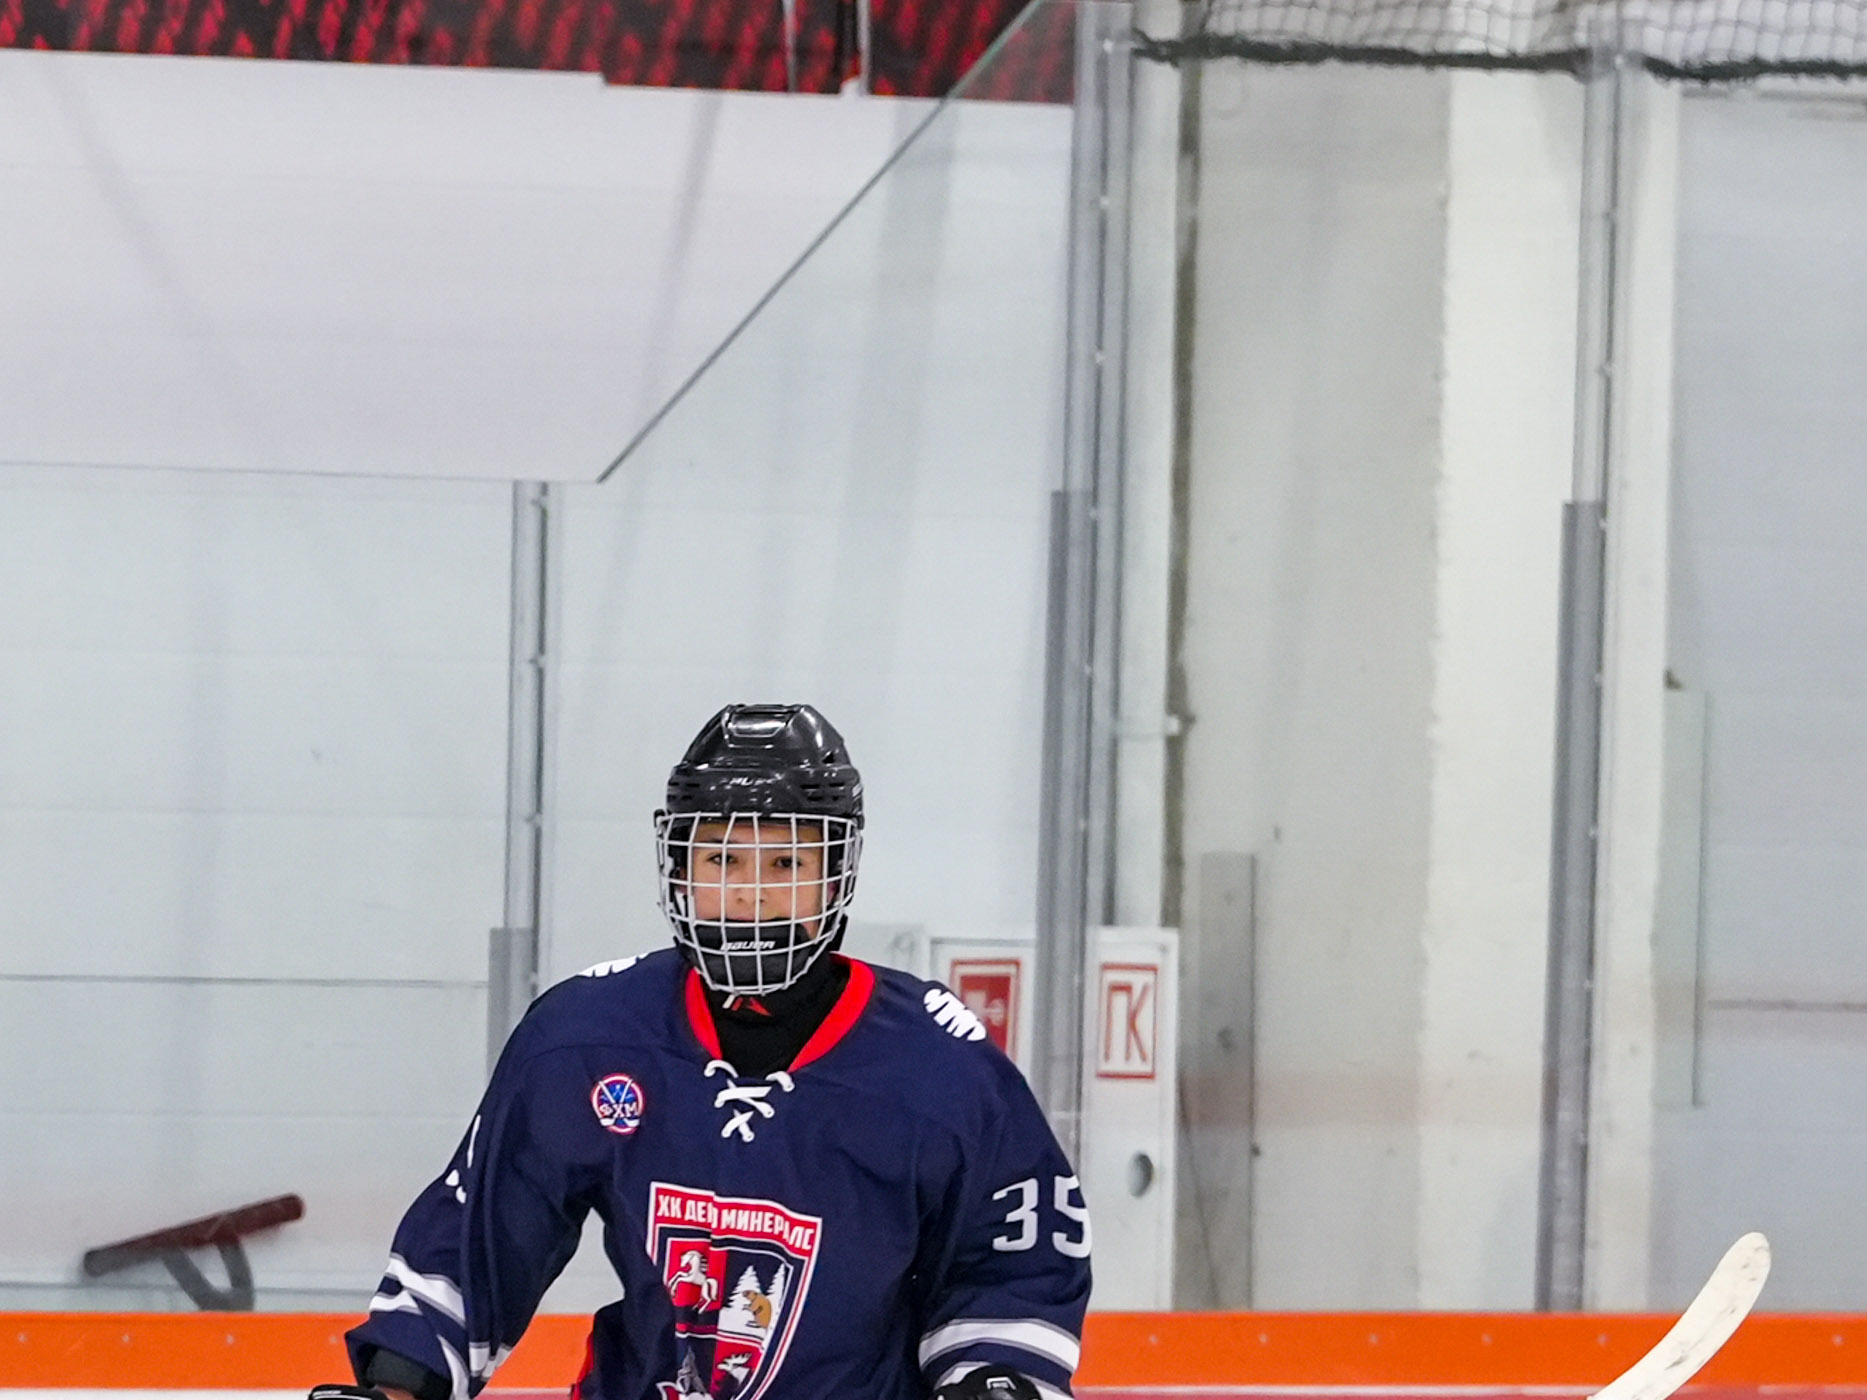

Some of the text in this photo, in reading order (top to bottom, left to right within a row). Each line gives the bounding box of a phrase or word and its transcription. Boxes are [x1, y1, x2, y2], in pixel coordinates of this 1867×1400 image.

[1103, 981, 1150, 1063] ПК
[657, 1195, 682, 1219] ХК
[992, 1175, 1092, 1259] 35
